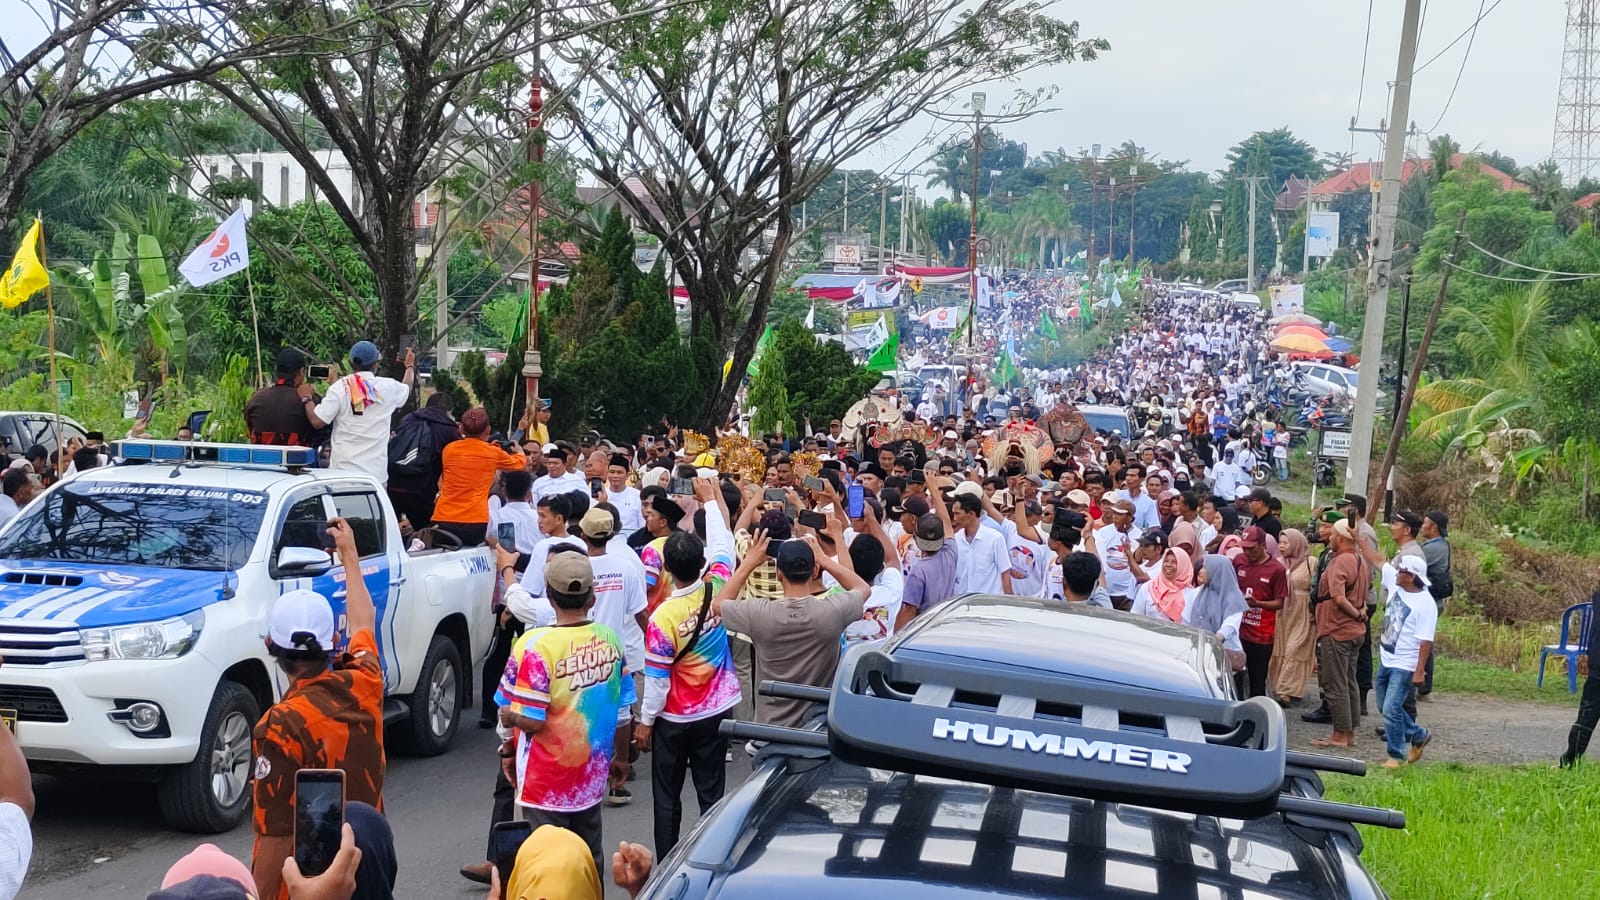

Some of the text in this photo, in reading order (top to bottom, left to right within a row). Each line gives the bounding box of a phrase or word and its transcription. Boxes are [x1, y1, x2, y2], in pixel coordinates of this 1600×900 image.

[88, 486, 263, 505] SATLANTAS POLRES SELUMA 903
[555, 644, 621, 679] SELUMA
[569, 662, 614, 691] ALAP
[932, 717, 1193, 774] HUMMER
